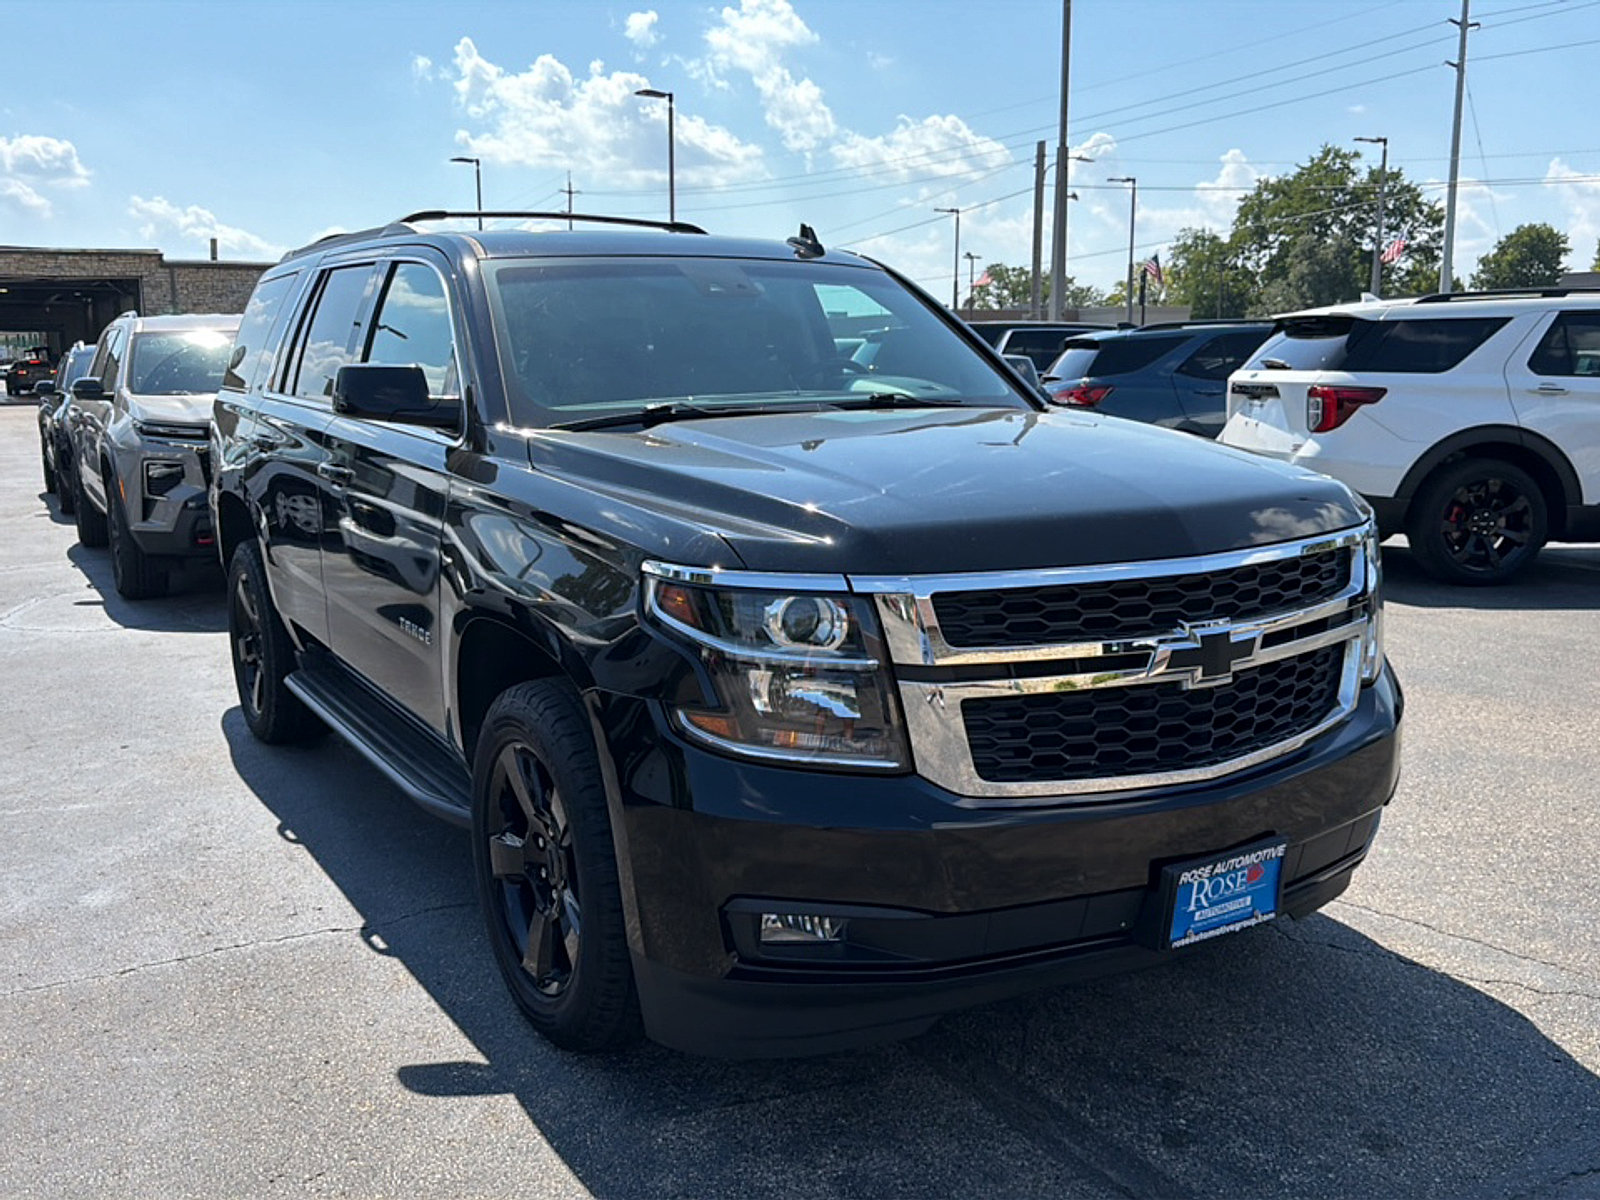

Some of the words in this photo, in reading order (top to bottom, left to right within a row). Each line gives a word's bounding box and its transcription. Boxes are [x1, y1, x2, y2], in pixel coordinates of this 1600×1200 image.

[399, 616, 431, 645] TAHOE
[1179, 865, 1213, 885] ROSE
[1213, 843, 1287, 876] AUTOMOTIVE
